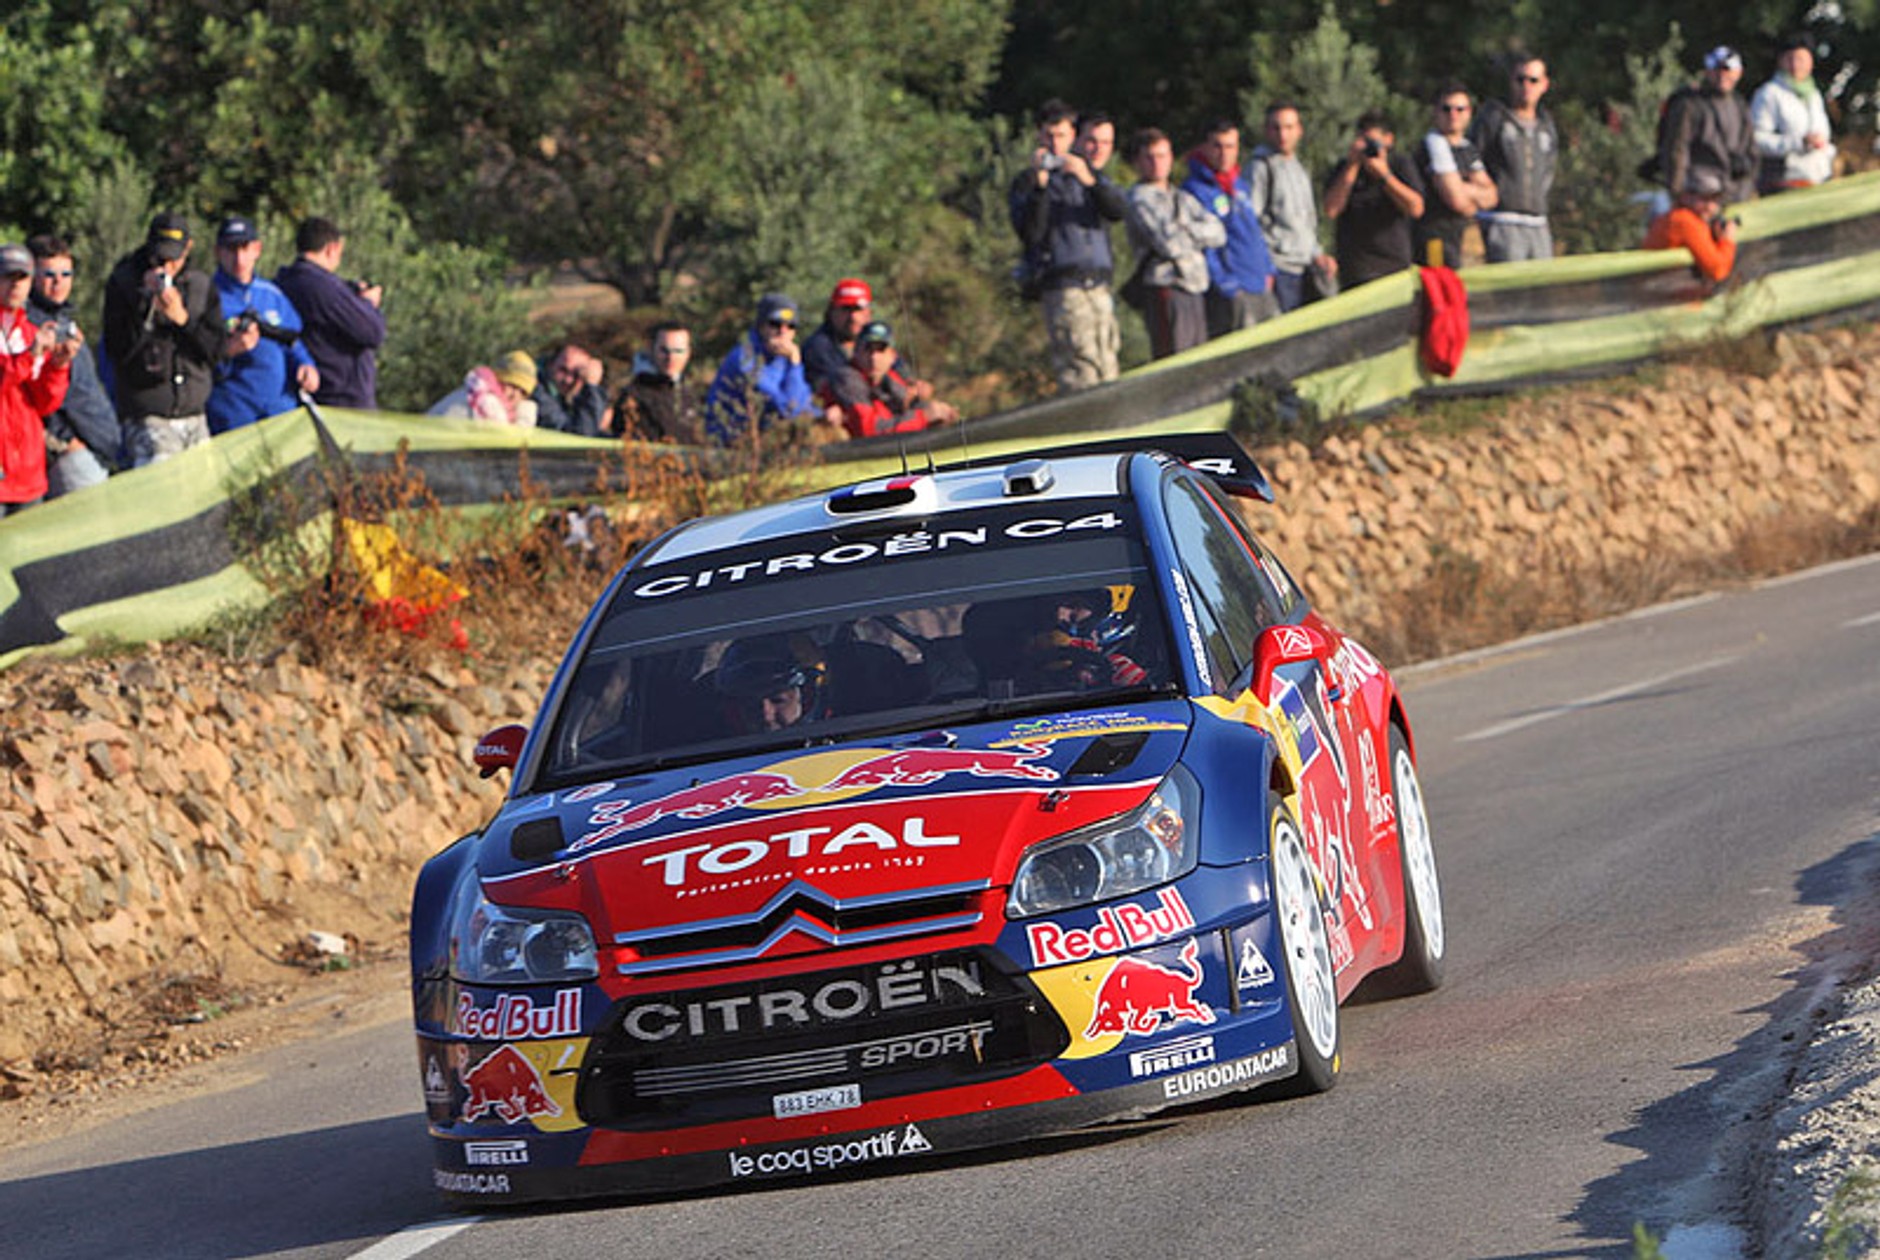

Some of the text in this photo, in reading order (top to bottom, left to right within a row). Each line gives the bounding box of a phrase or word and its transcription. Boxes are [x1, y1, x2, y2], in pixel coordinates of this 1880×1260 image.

[634, 512, 1122, 598] CITROËN C4
[643, 818, 960, 886] TOTAL
[1029, 887, 1194, 965] Red Bull
[454, 989, 580, 1037] Red Bull
[623, 959, 986, 1041] CITROËN
[861, 1026, 993, 1069] SPORT
[1129, 1036, 1215, 1077] PIRELLI
[1163, 1047, 1288, 1098] EURODATACAR
[464, 1140, 529, 1165] PIRELLI
[729, 1131, 897, 1176] le coq sportif
